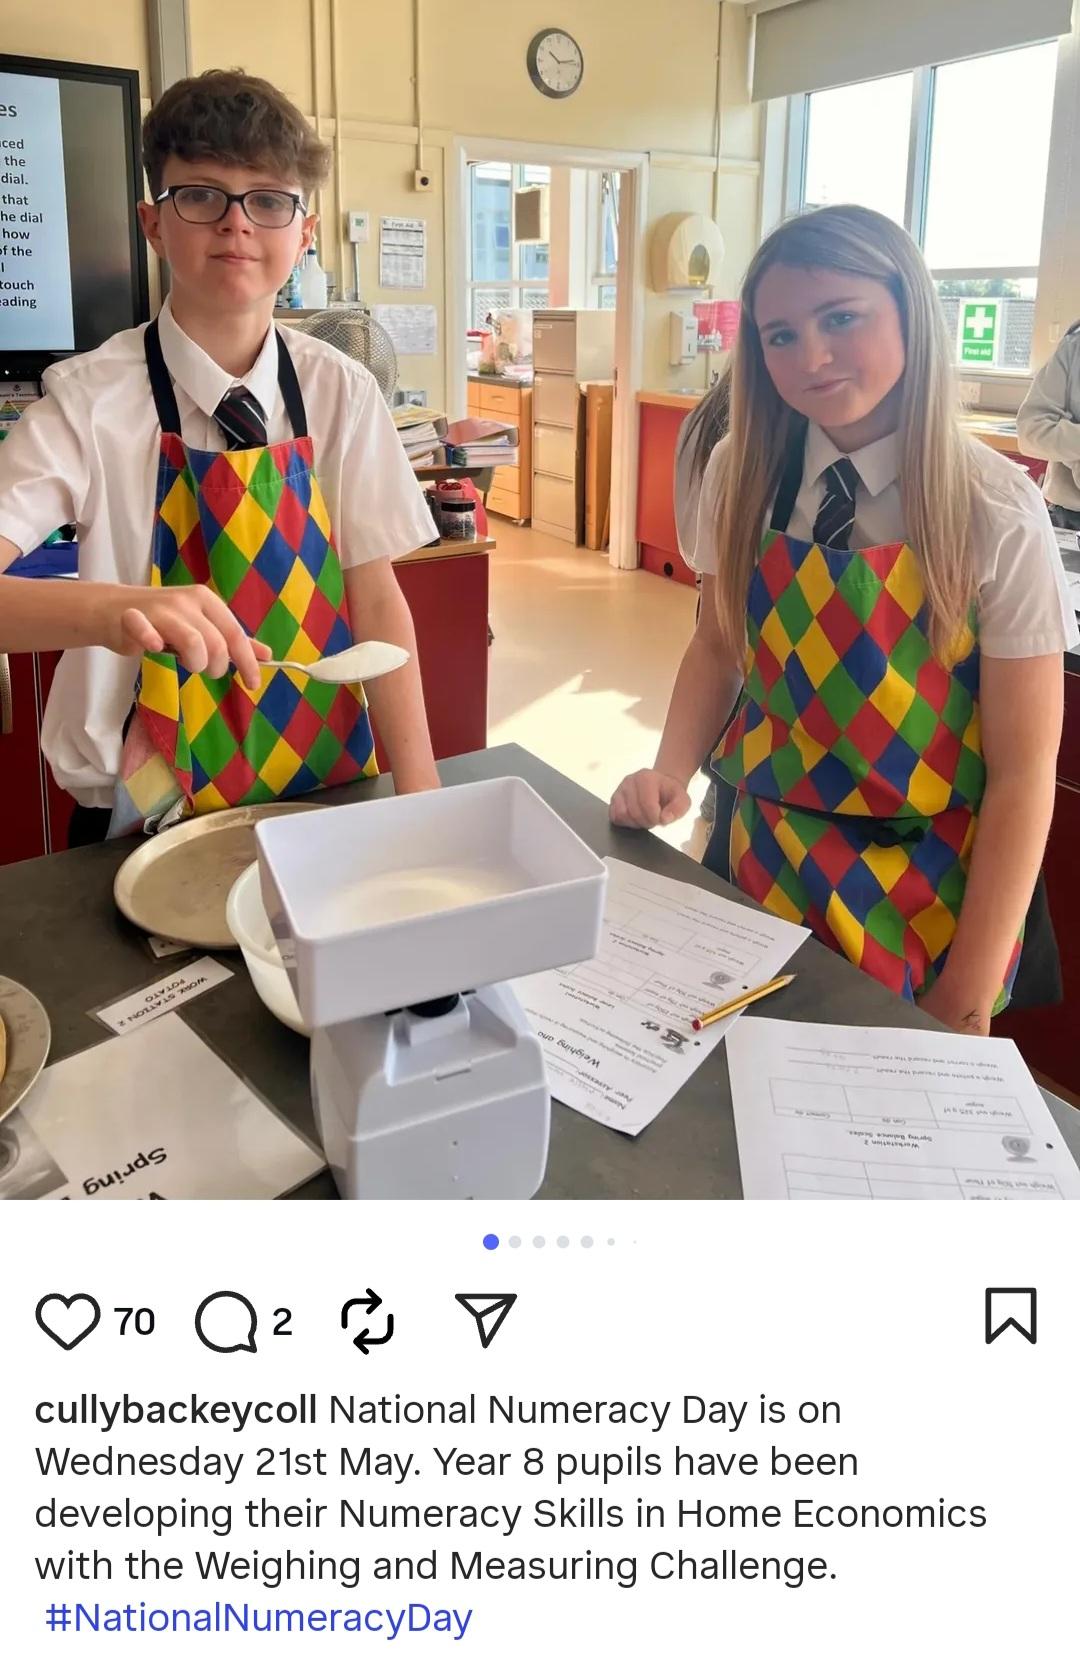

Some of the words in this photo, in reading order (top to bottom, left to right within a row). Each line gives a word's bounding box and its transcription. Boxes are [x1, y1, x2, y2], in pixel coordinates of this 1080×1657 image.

[0, 139, 24, 150] ced
[4, 155, 26, 167] the
[1, 172, 29, 185] dial.
[2, 194, 29, 206] that
[20, 212, 43, 223] dial
[2, 228, 30, 240] how
[11, 245, 33, 257] the
[144, 978, 186, 1003] POTATO
[177, 976, 208, 994] WORK
[127, 994, 176, 1022] STATION
[556, 1038, 601, 1068] Weighing
[82, 1147, 168, 1196] Spring
